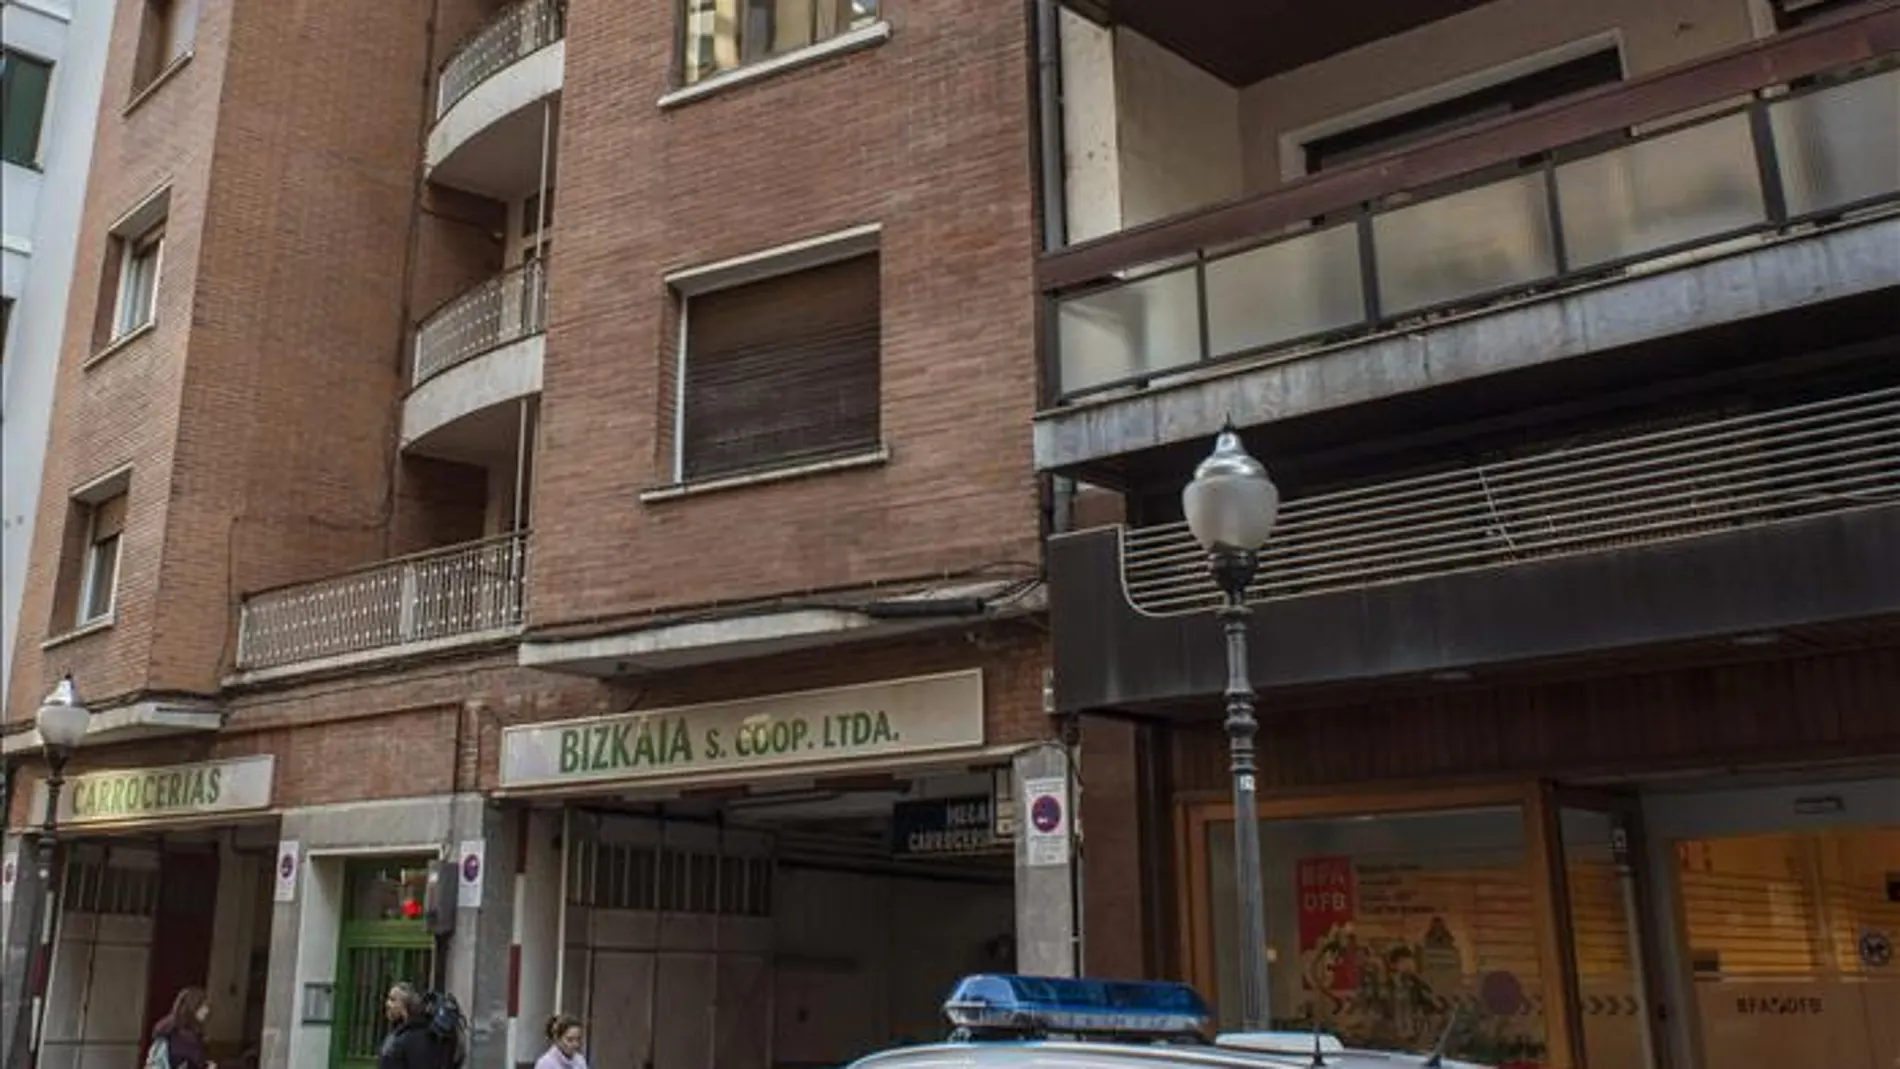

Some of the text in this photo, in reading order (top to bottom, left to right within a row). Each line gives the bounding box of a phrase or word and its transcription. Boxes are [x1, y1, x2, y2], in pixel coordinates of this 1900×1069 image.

[560, 710, 900, 774] BIZKAIA S. COOP. LTDA.
[72, 768, 221, 815] CARROCERIAS
